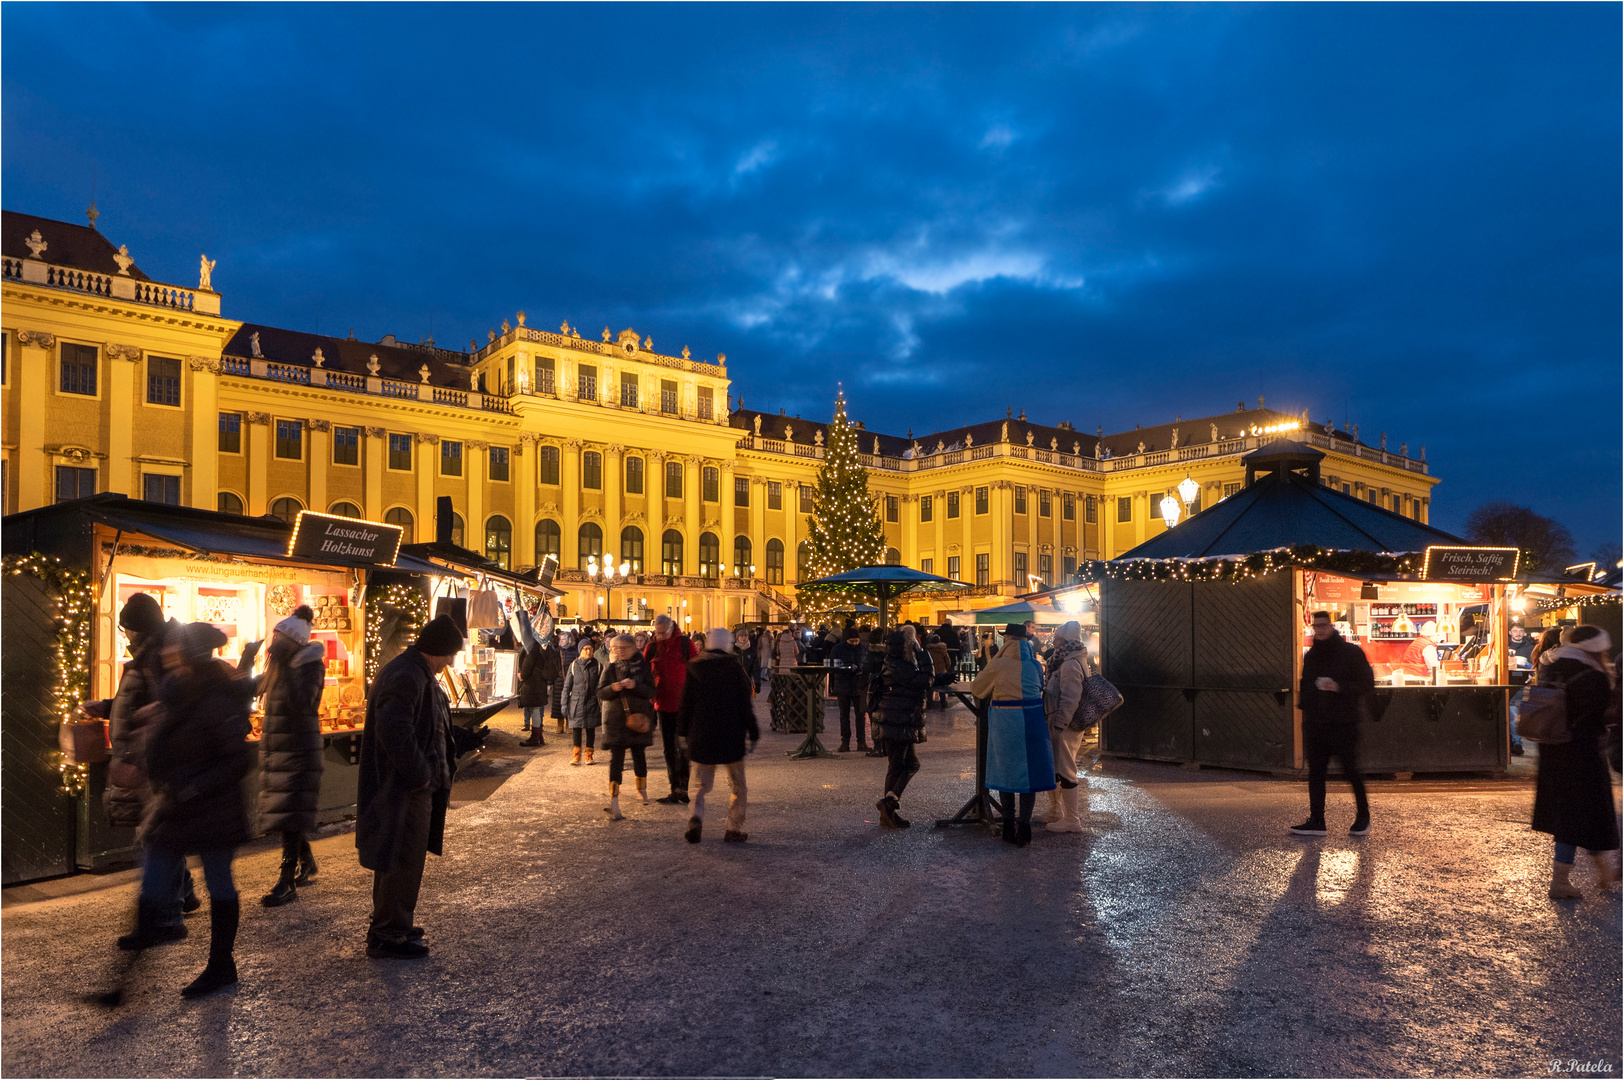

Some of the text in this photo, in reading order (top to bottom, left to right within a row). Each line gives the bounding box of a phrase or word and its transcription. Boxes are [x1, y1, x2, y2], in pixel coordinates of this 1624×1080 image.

[324, 523, 379, 542] Lassacher
[319, 539, 375, 558] Holzkunst
[1441, 552, 1504, 566] Frisch, Saftig
[186, 565, 297, 581] www.lungauerhandwerk.at
[1447, 565, 1493, 575] Steirisch!
